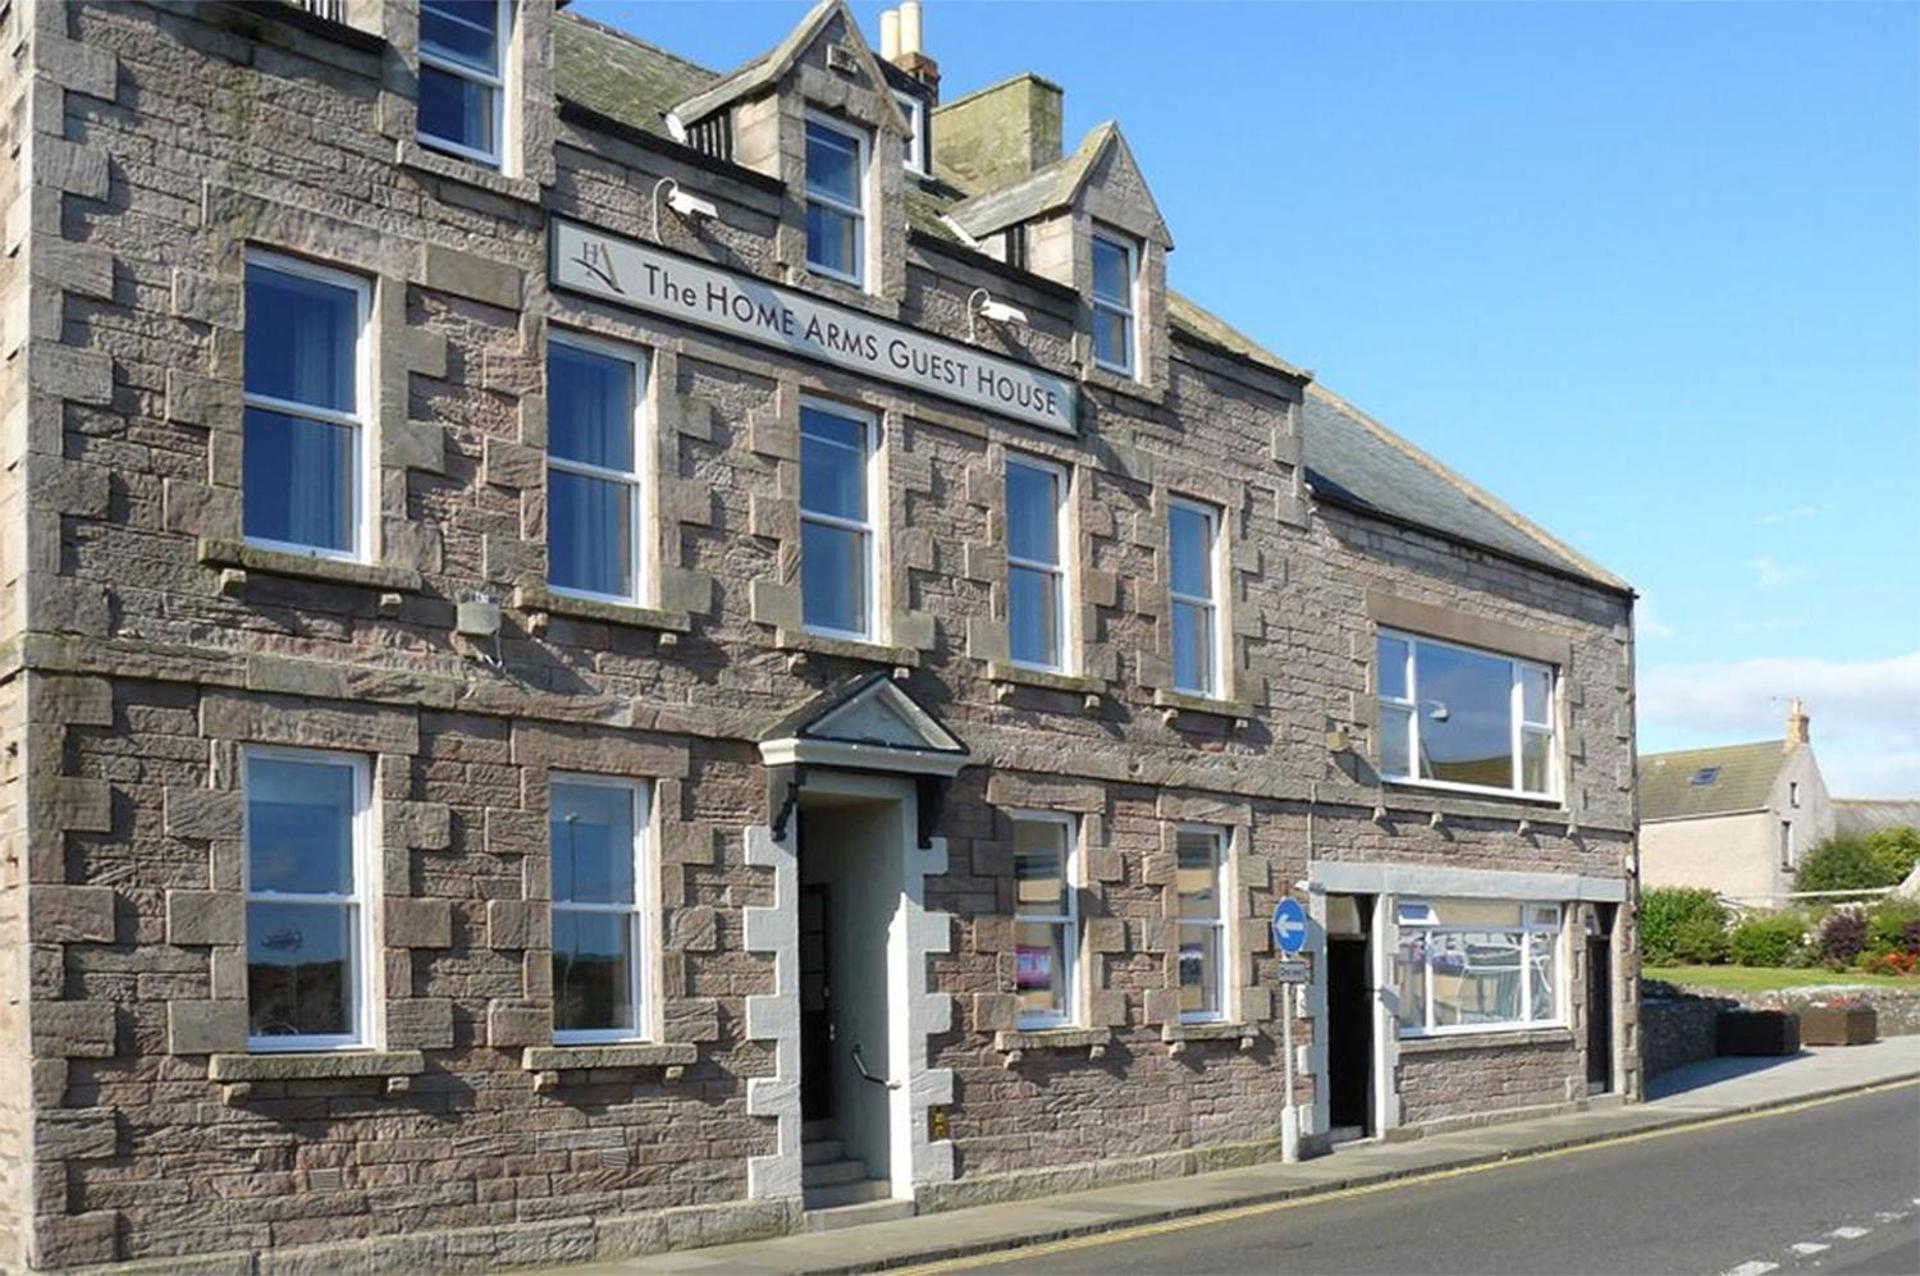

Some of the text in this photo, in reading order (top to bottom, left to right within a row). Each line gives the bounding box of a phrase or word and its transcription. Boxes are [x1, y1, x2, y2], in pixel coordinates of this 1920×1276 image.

[643, 263, 1056, 415] The HOME ARMS GUEST HOUSE
